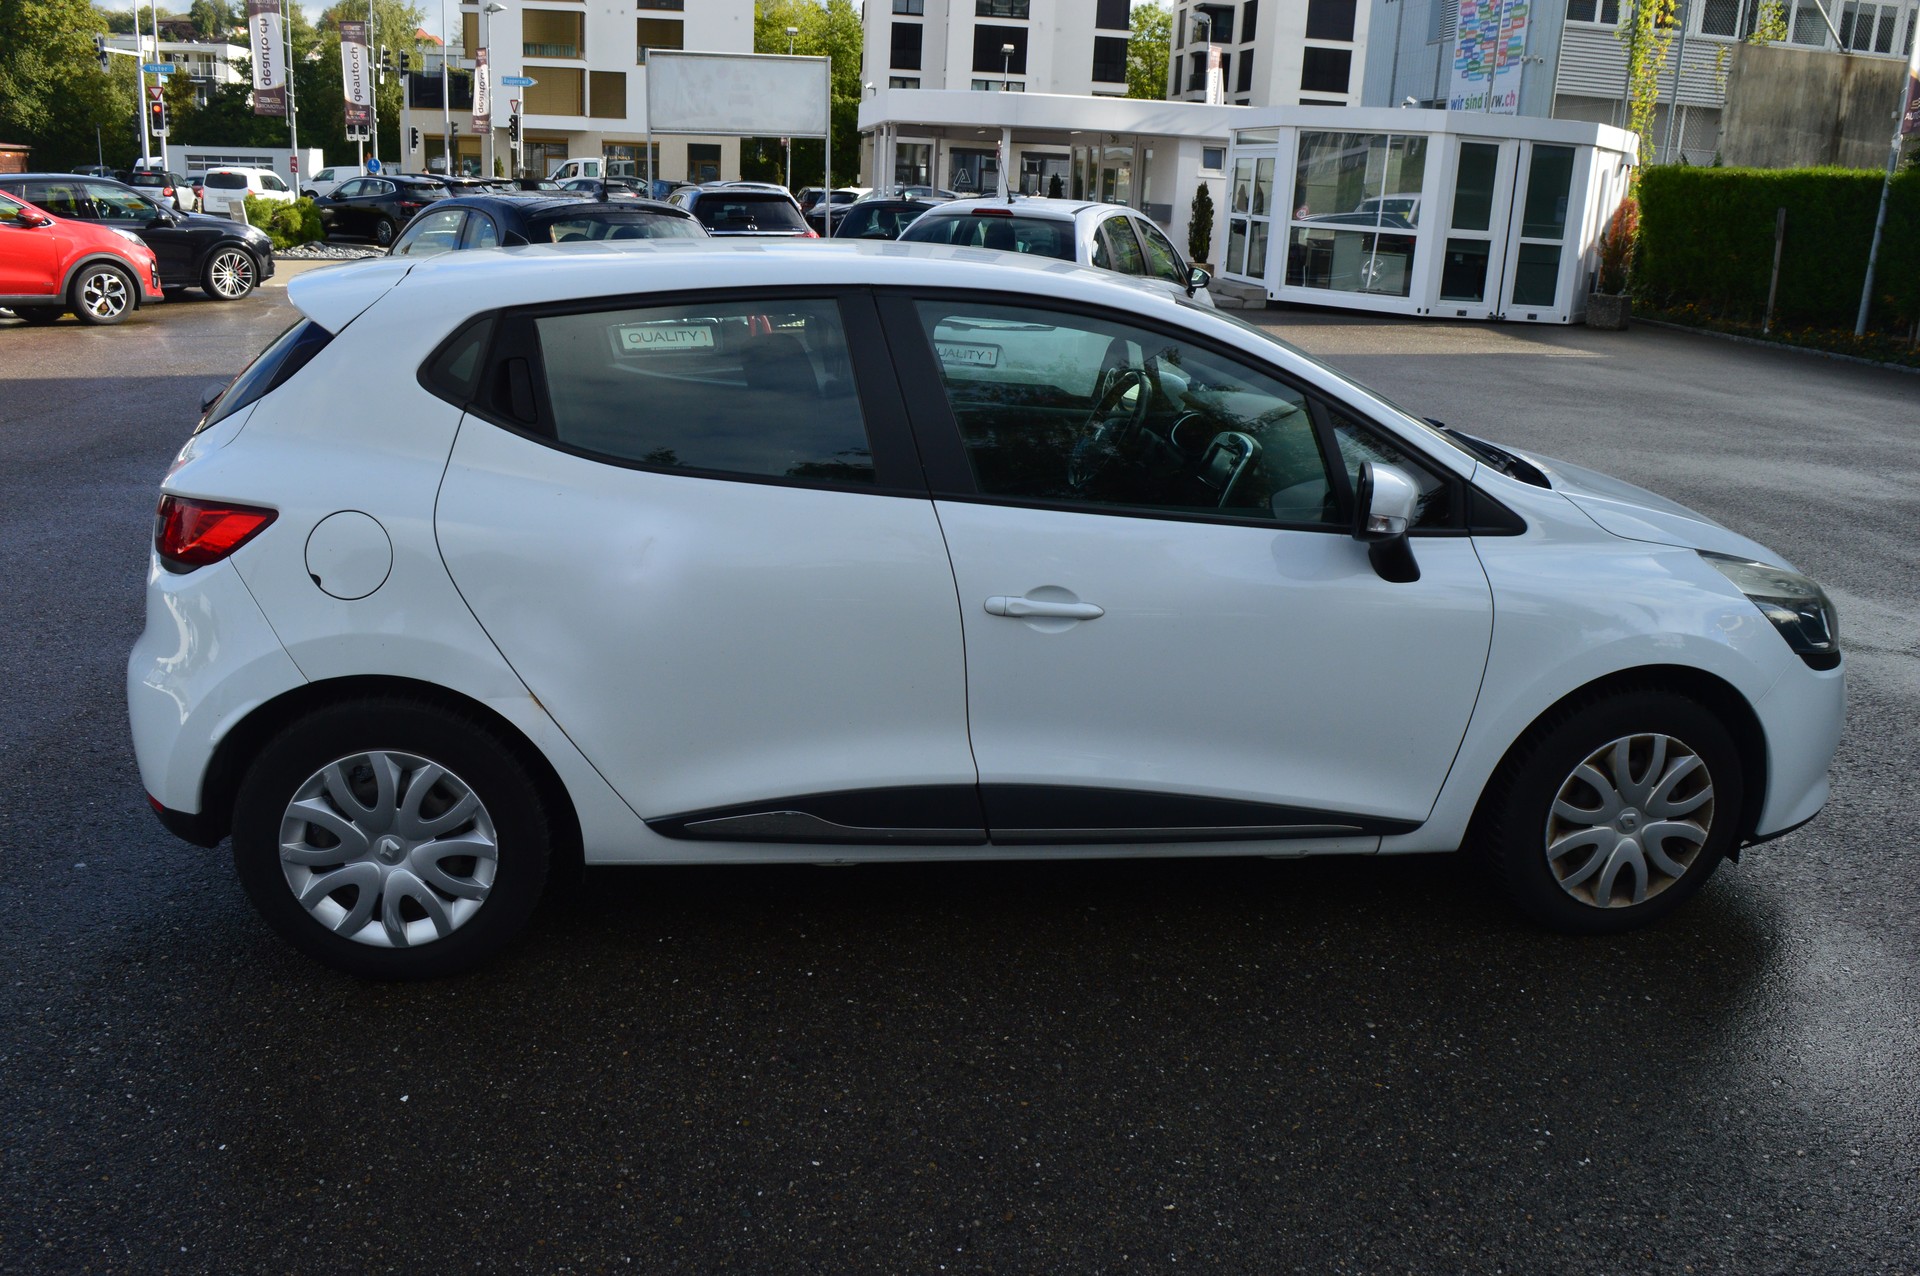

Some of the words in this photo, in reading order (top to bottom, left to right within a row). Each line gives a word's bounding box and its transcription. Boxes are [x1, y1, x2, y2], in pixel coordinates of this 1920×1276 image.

[350, 46, 364, 103] geauto.ch
[1451, 95, 1464, 110] wir
[1465, 93, 1484, 110] sind
[628, 331, 698, 344] QUALITY
[700, 330, 708, 341] 1
[937, 347, 985, 360] UALITY
[987, 351, 993, 361] 1
